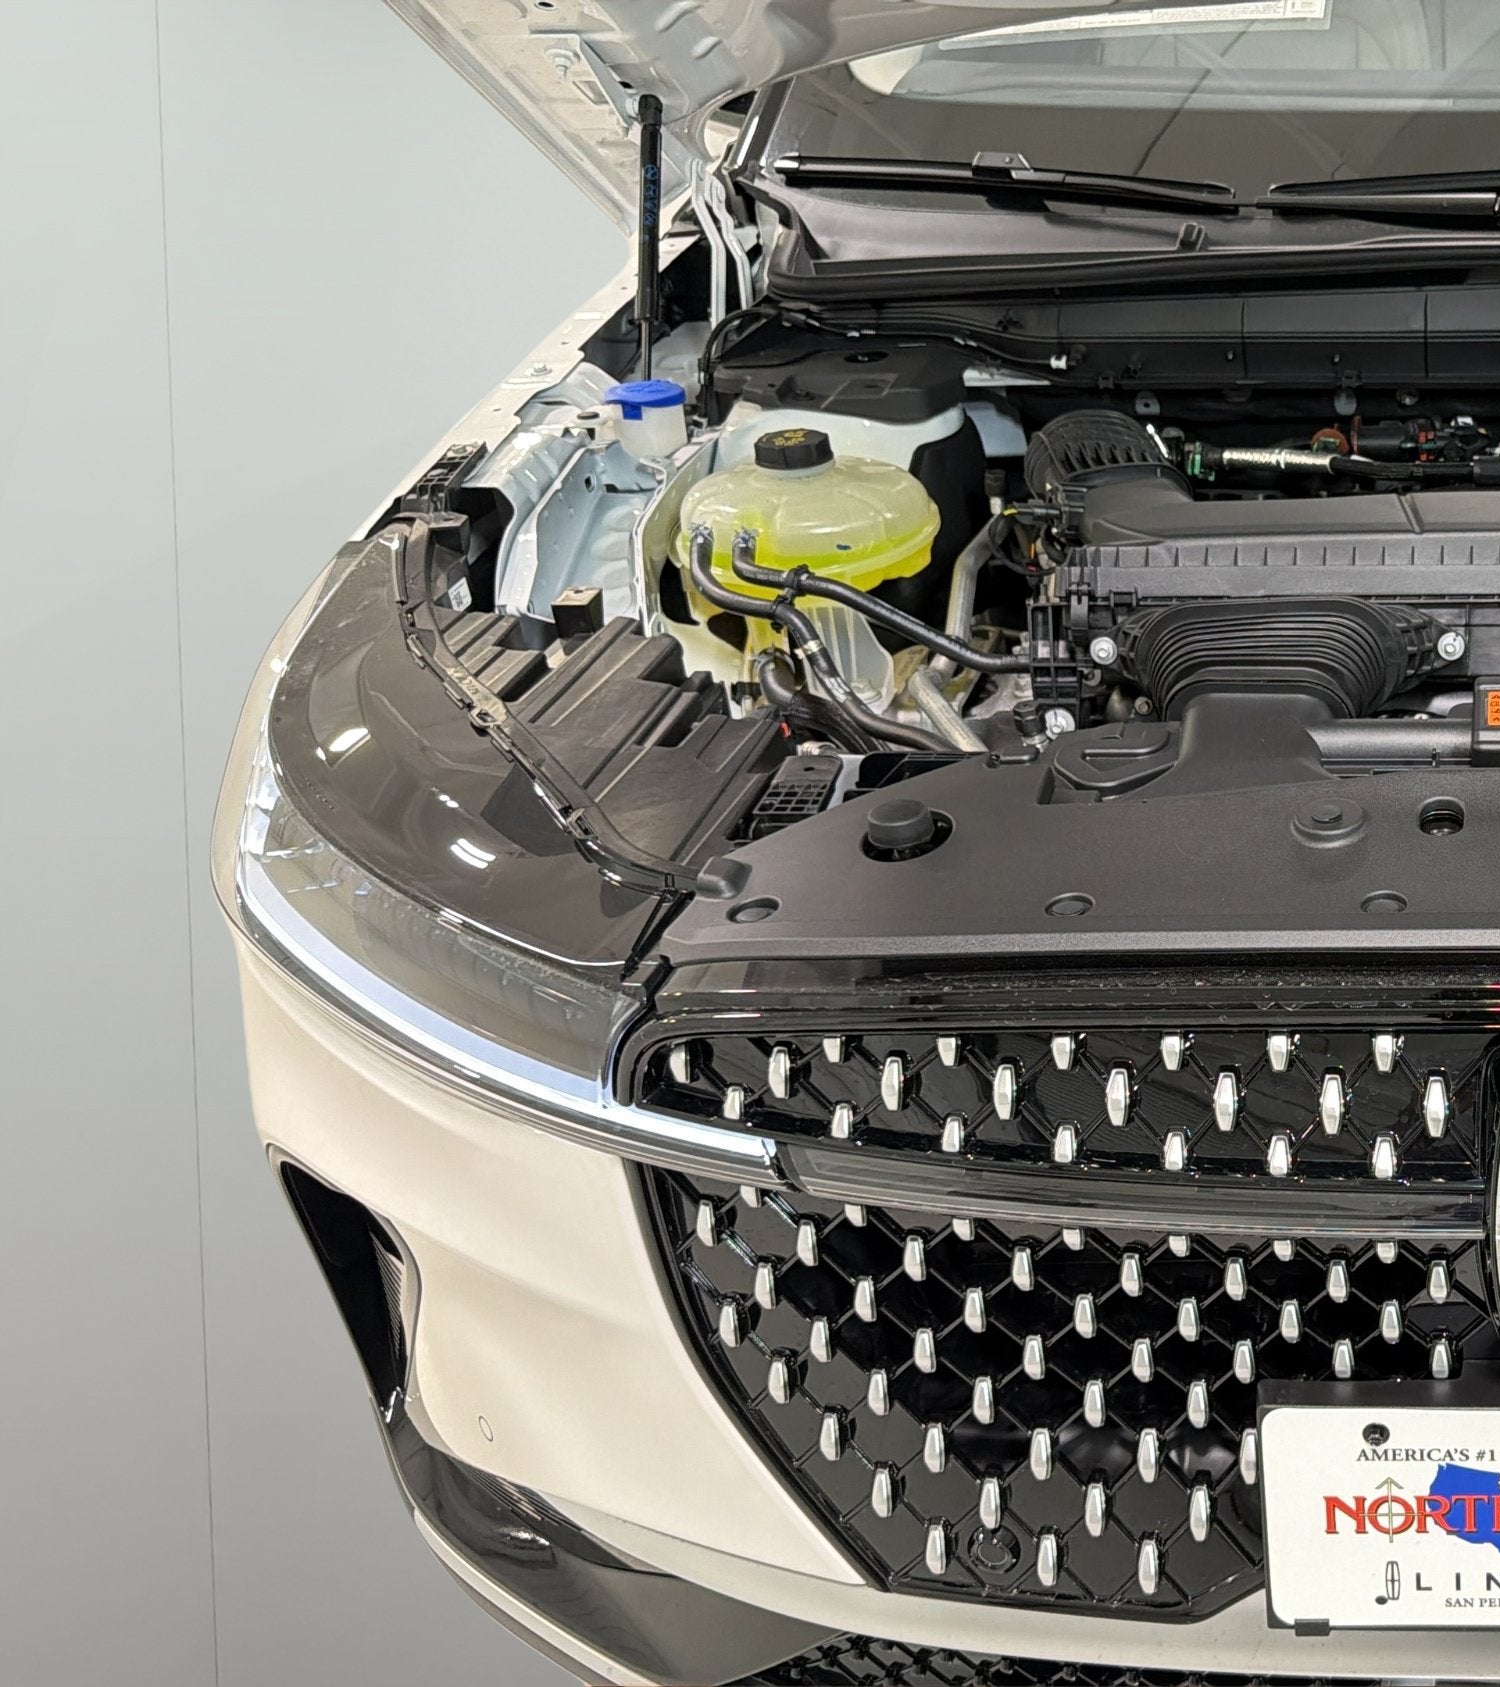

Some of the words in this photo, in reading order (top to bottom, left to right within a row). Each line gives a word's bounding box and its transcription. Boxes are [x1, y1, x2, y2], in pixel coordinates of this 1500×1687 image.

[1356, 1448, 1470, 1462] AMERICA'S
[1475, 1448, 1497, 1462] #1
[1444, 1597, 1475, 1609] SAN
